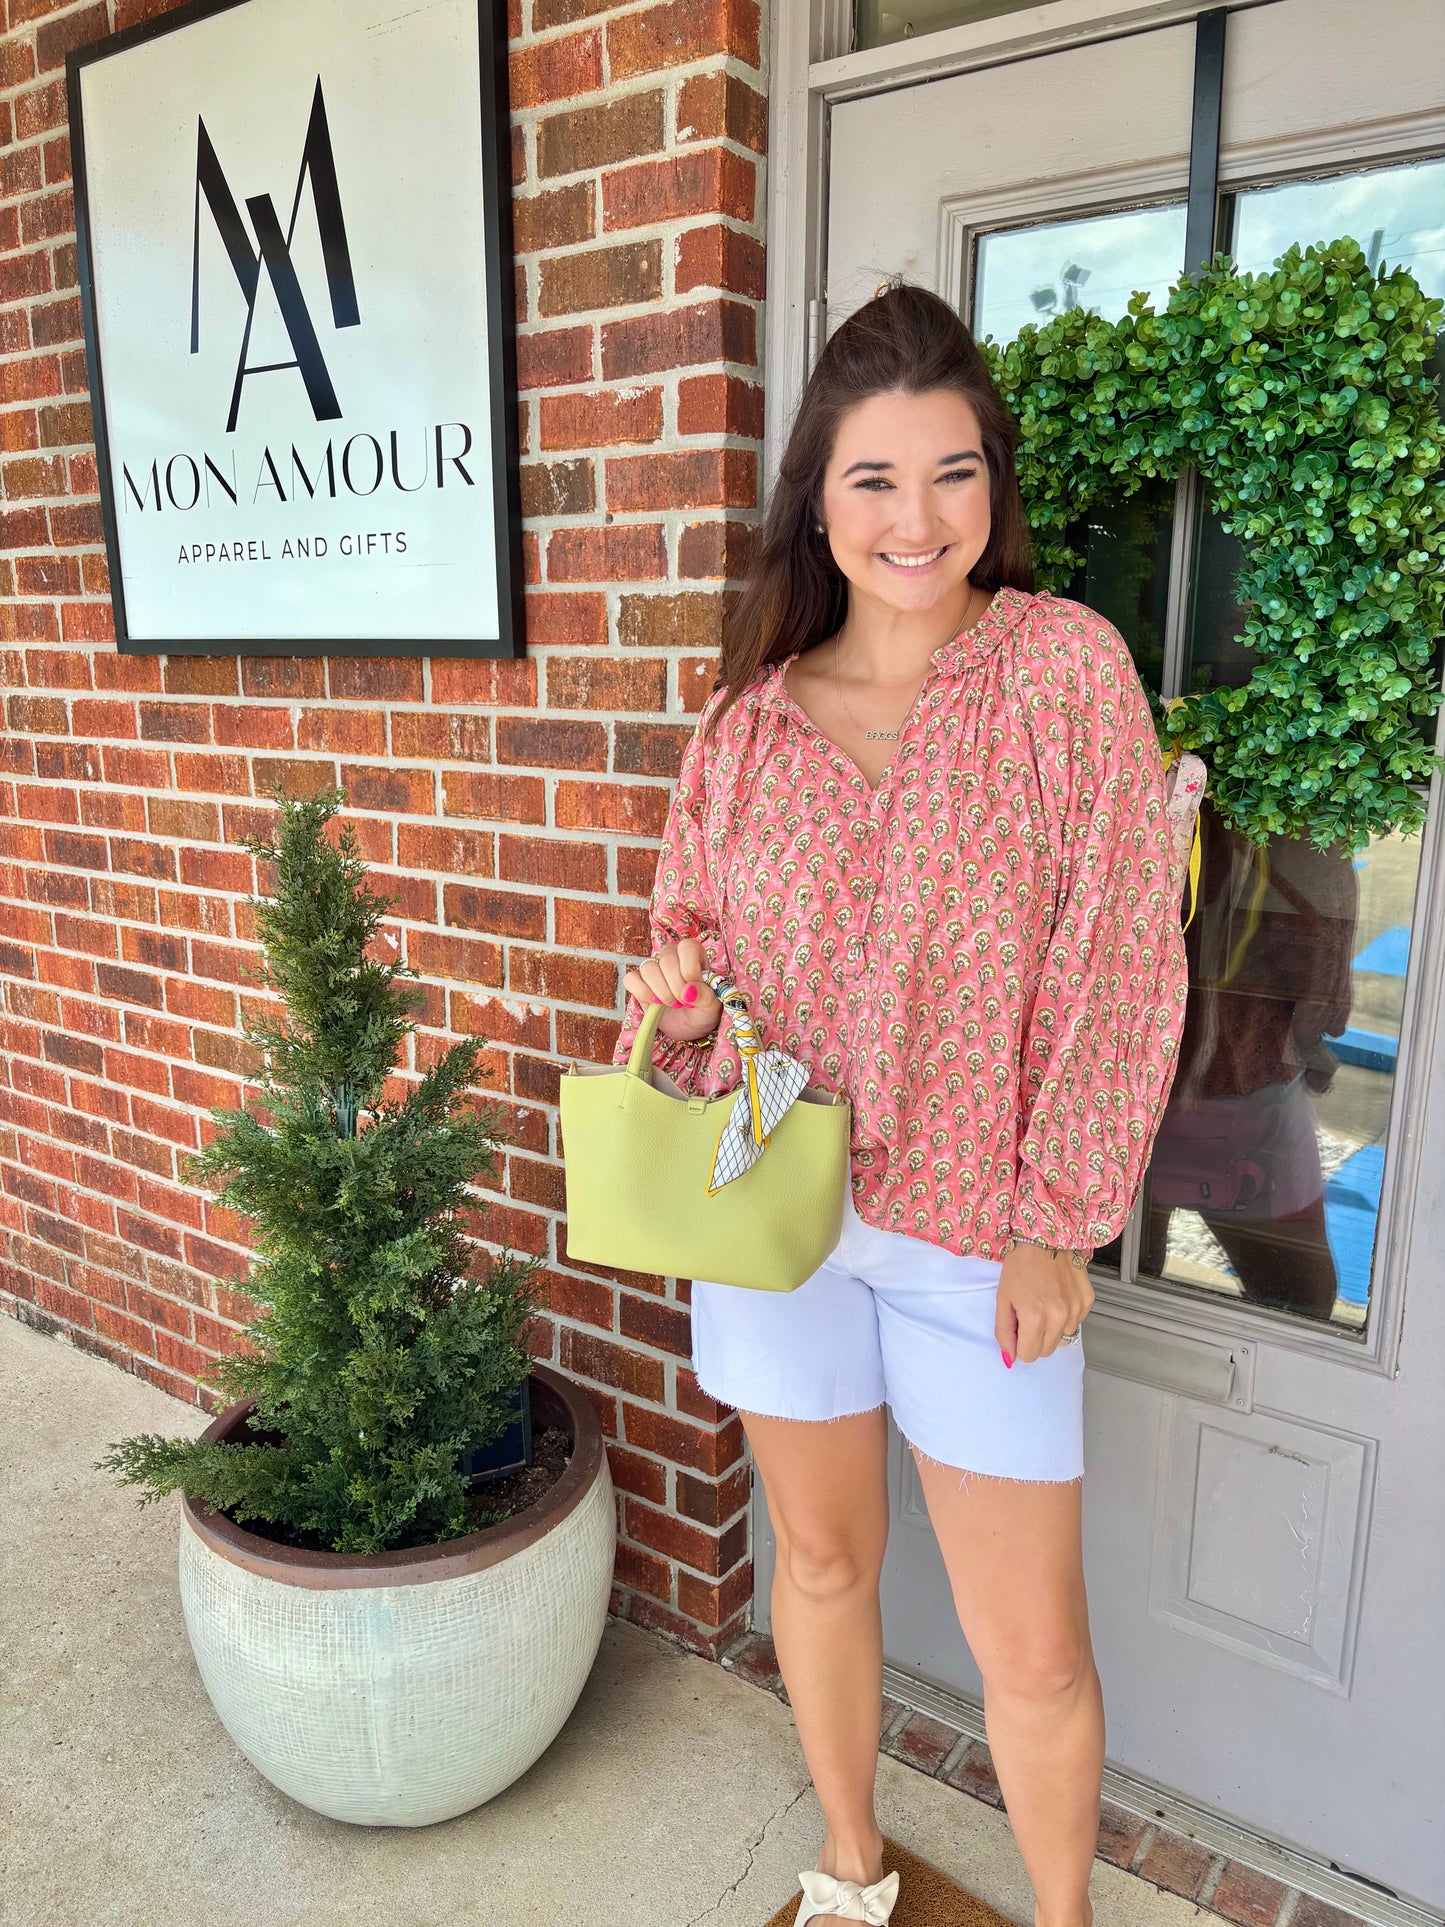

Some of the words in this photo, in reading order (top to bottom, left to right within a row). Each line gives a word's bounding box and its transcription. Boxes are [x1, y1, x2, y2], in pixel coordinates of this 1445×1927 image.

[122, 448, 238, 514] MON
[252, 422, 476, 505] AMOUR
[178, 540, 272, 564] APPAREL
[281, 536, 328, 560] AND
[339, 531, 407, 556] GIFTS
